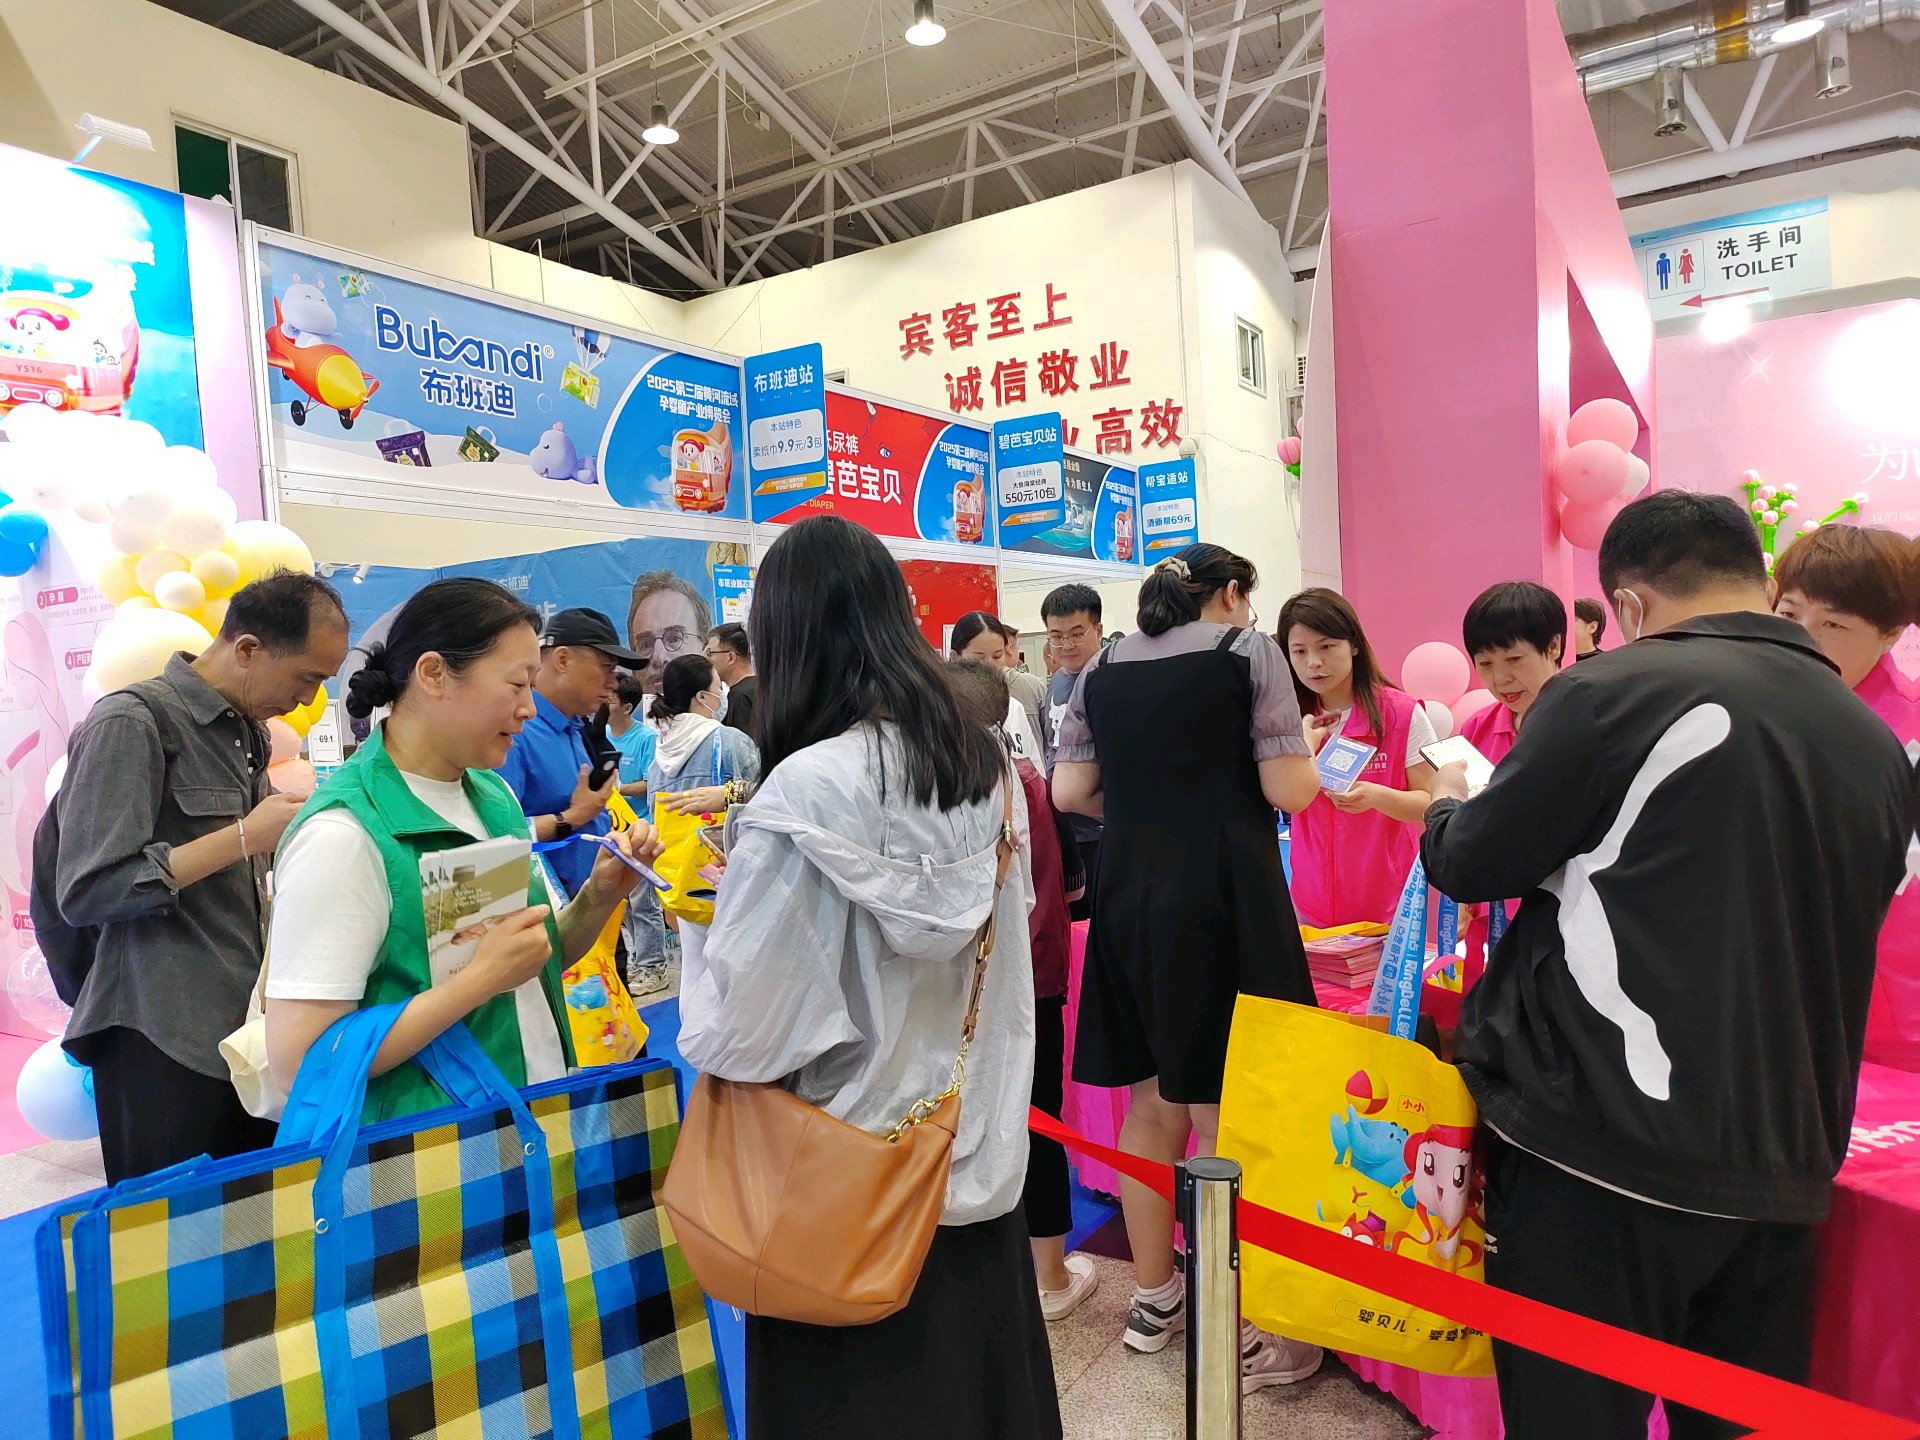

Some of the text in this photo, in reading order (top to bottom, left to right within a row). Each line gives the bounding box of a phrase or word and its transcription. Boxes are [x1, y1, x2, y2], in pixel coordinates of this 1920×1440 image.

[1717, 226, 1801, 259] 洗手间
[1721, 254, 1798, 280] TOILET
[899, 283, 1073, 361] 宾客至上
[375, 305, 543, 382] Bubandi
[647, 374, 739, 408] 2025第三届黄河流域
[754, 364, 814, 394] 布班迪站
[944, 341, 1131, 413] 诚信敬业
[421, 368, 515, 417] 布班迪
[659, 395, 731, 424] 孕婴童产业博览会
[770, 418, 802, 432] 本站特色
[998, 427, 1057, 450] 碧芭宝贝站
[1145, 471, 1188, 488] 帮宝适站
[810, 499, 834, 510] DIAPER
[1005, 487, 1057, 503] 550元10包
[1402, 1098, 1425, 1113] 小小
